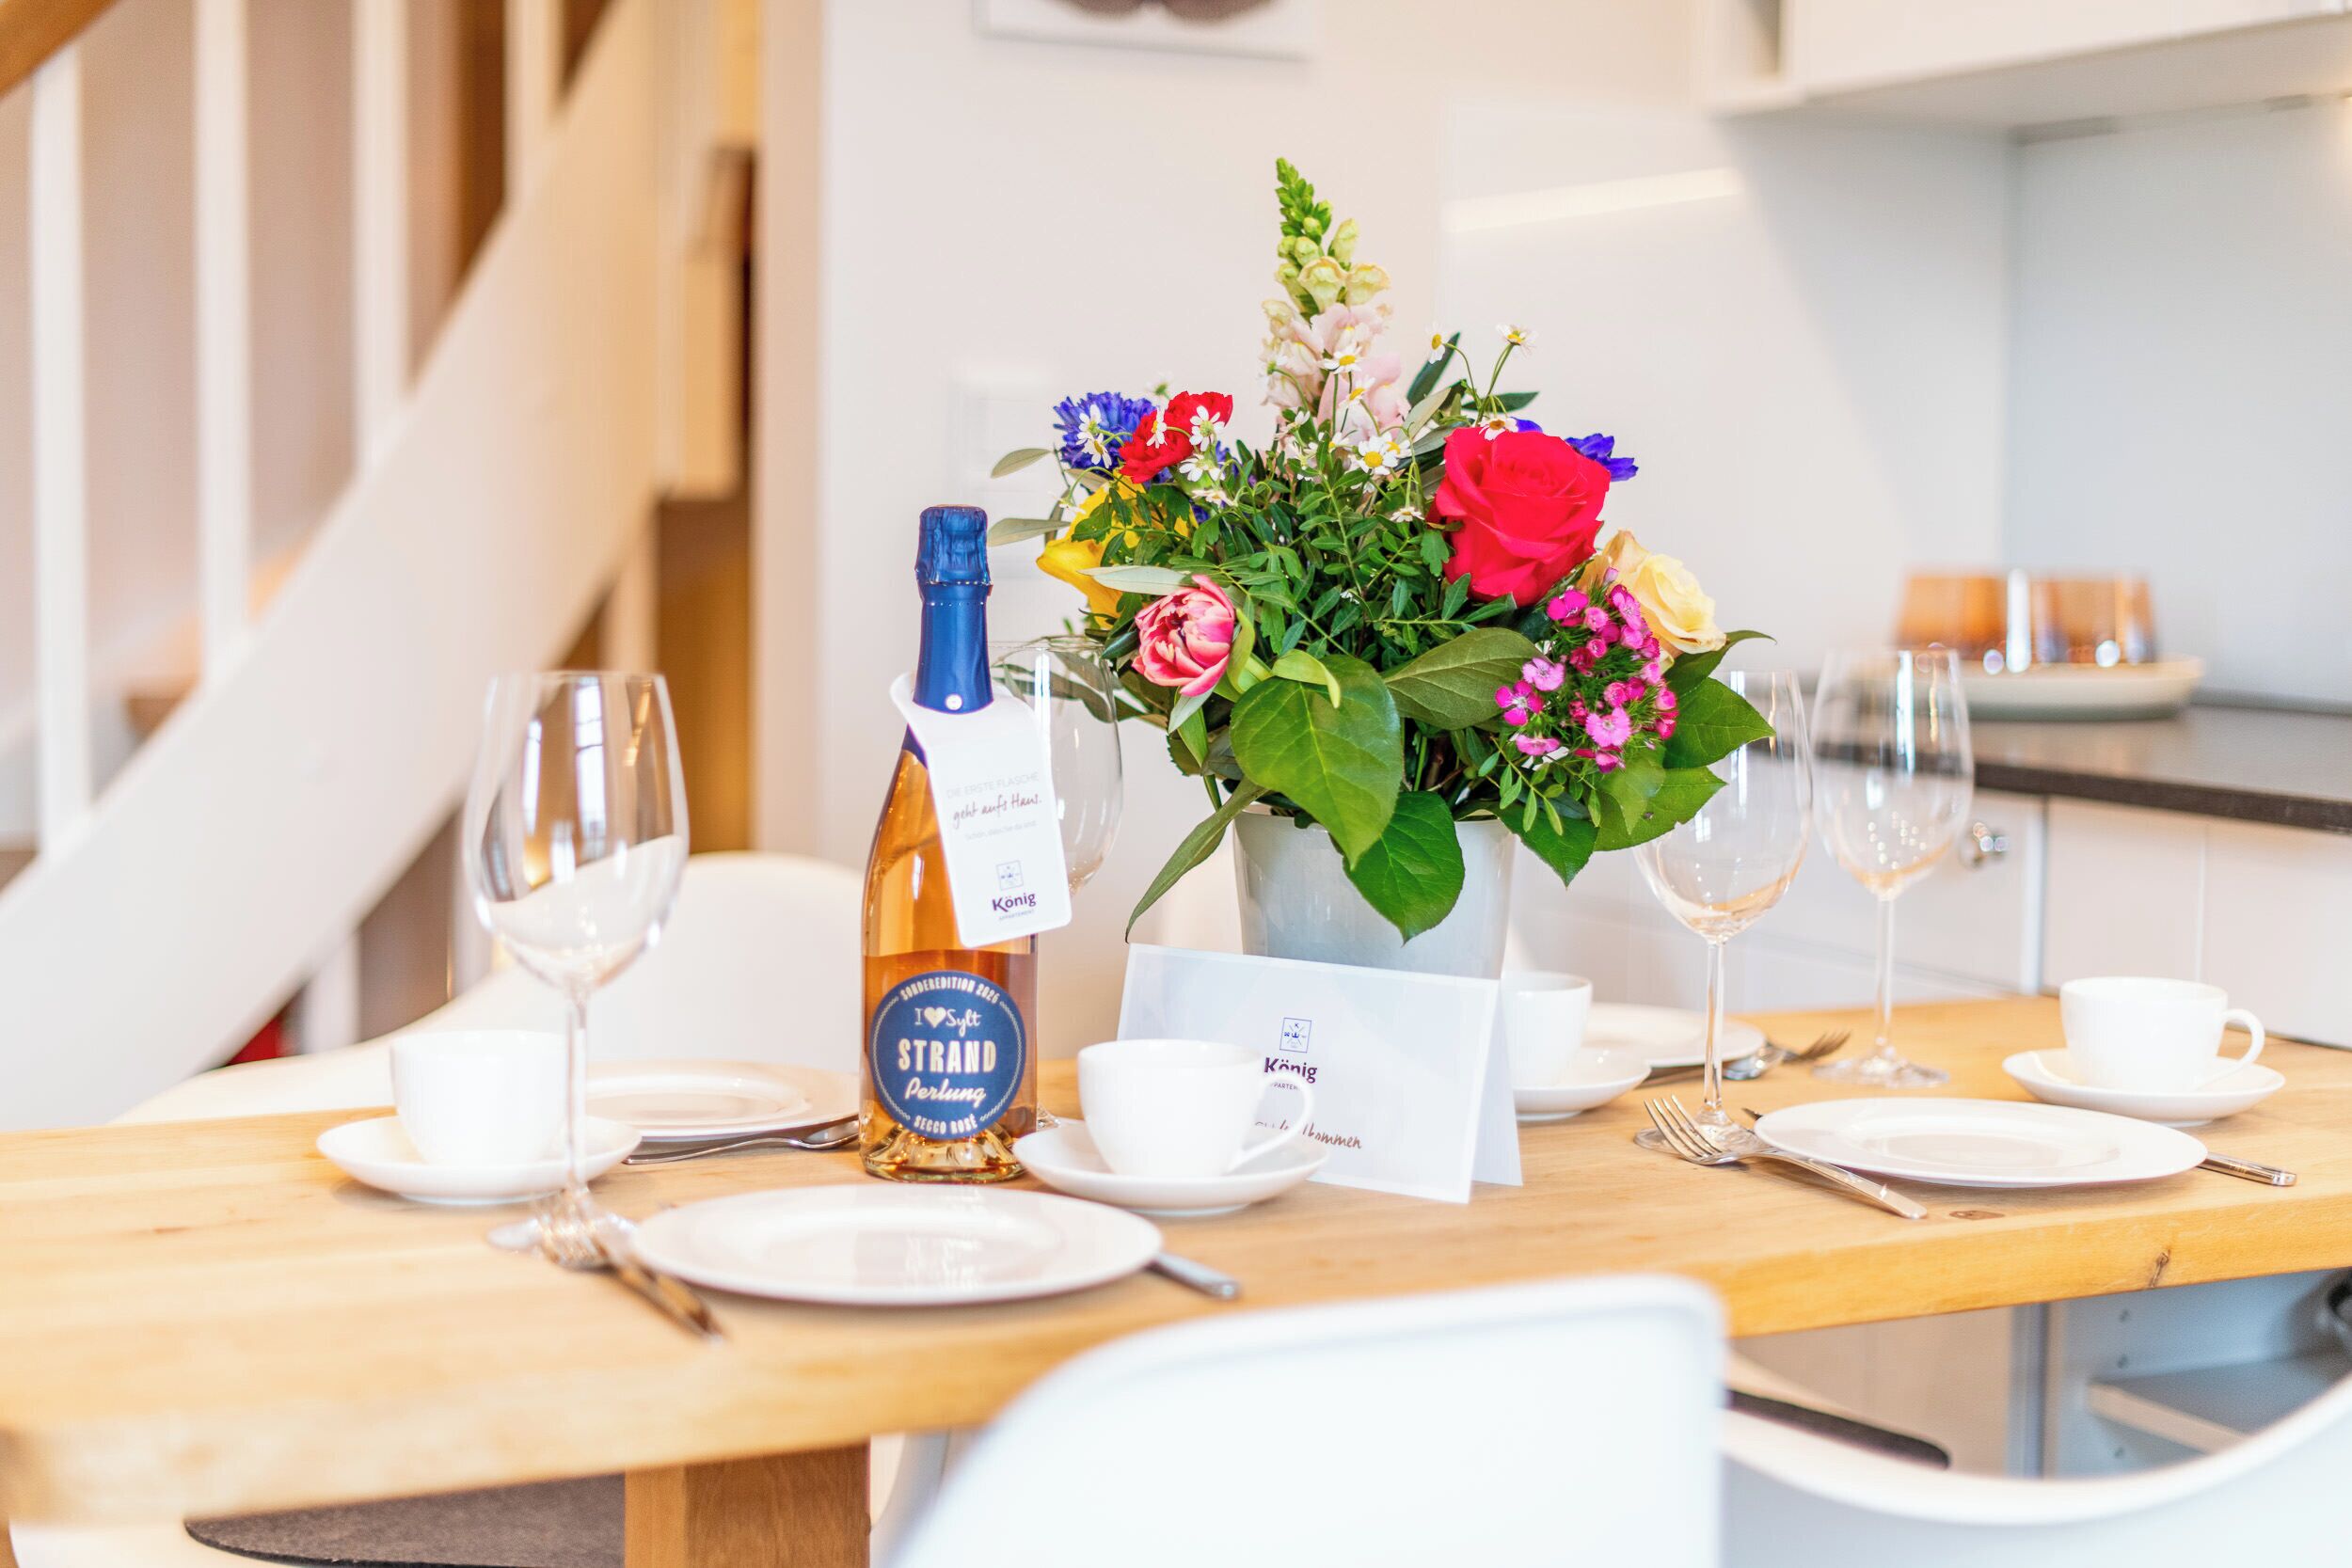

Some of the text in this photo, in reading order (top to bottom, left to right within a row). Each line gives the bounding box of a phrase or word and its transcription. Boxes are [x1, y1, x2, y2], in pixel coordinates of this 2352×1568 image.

[964, 782, 993, 795] ERSTE
[996, 771, 1040, 787] FLASCHE
[953, 800, 978, 829] geht
[981, 794, 1008, 817] aufs
[992, 892, 1037, 913] König
[899, 975, 977, 1001] SONDEREDITION
[914, 1007, 983, 1037] I Sylt
[898, 1037, 997, 1073] STRAND
[1263, 1057, 1318, 1084] König
[904, 1077, 987, 1108] Perlung
[914, 1113, 978, 1134] SECCO ROSÉ
